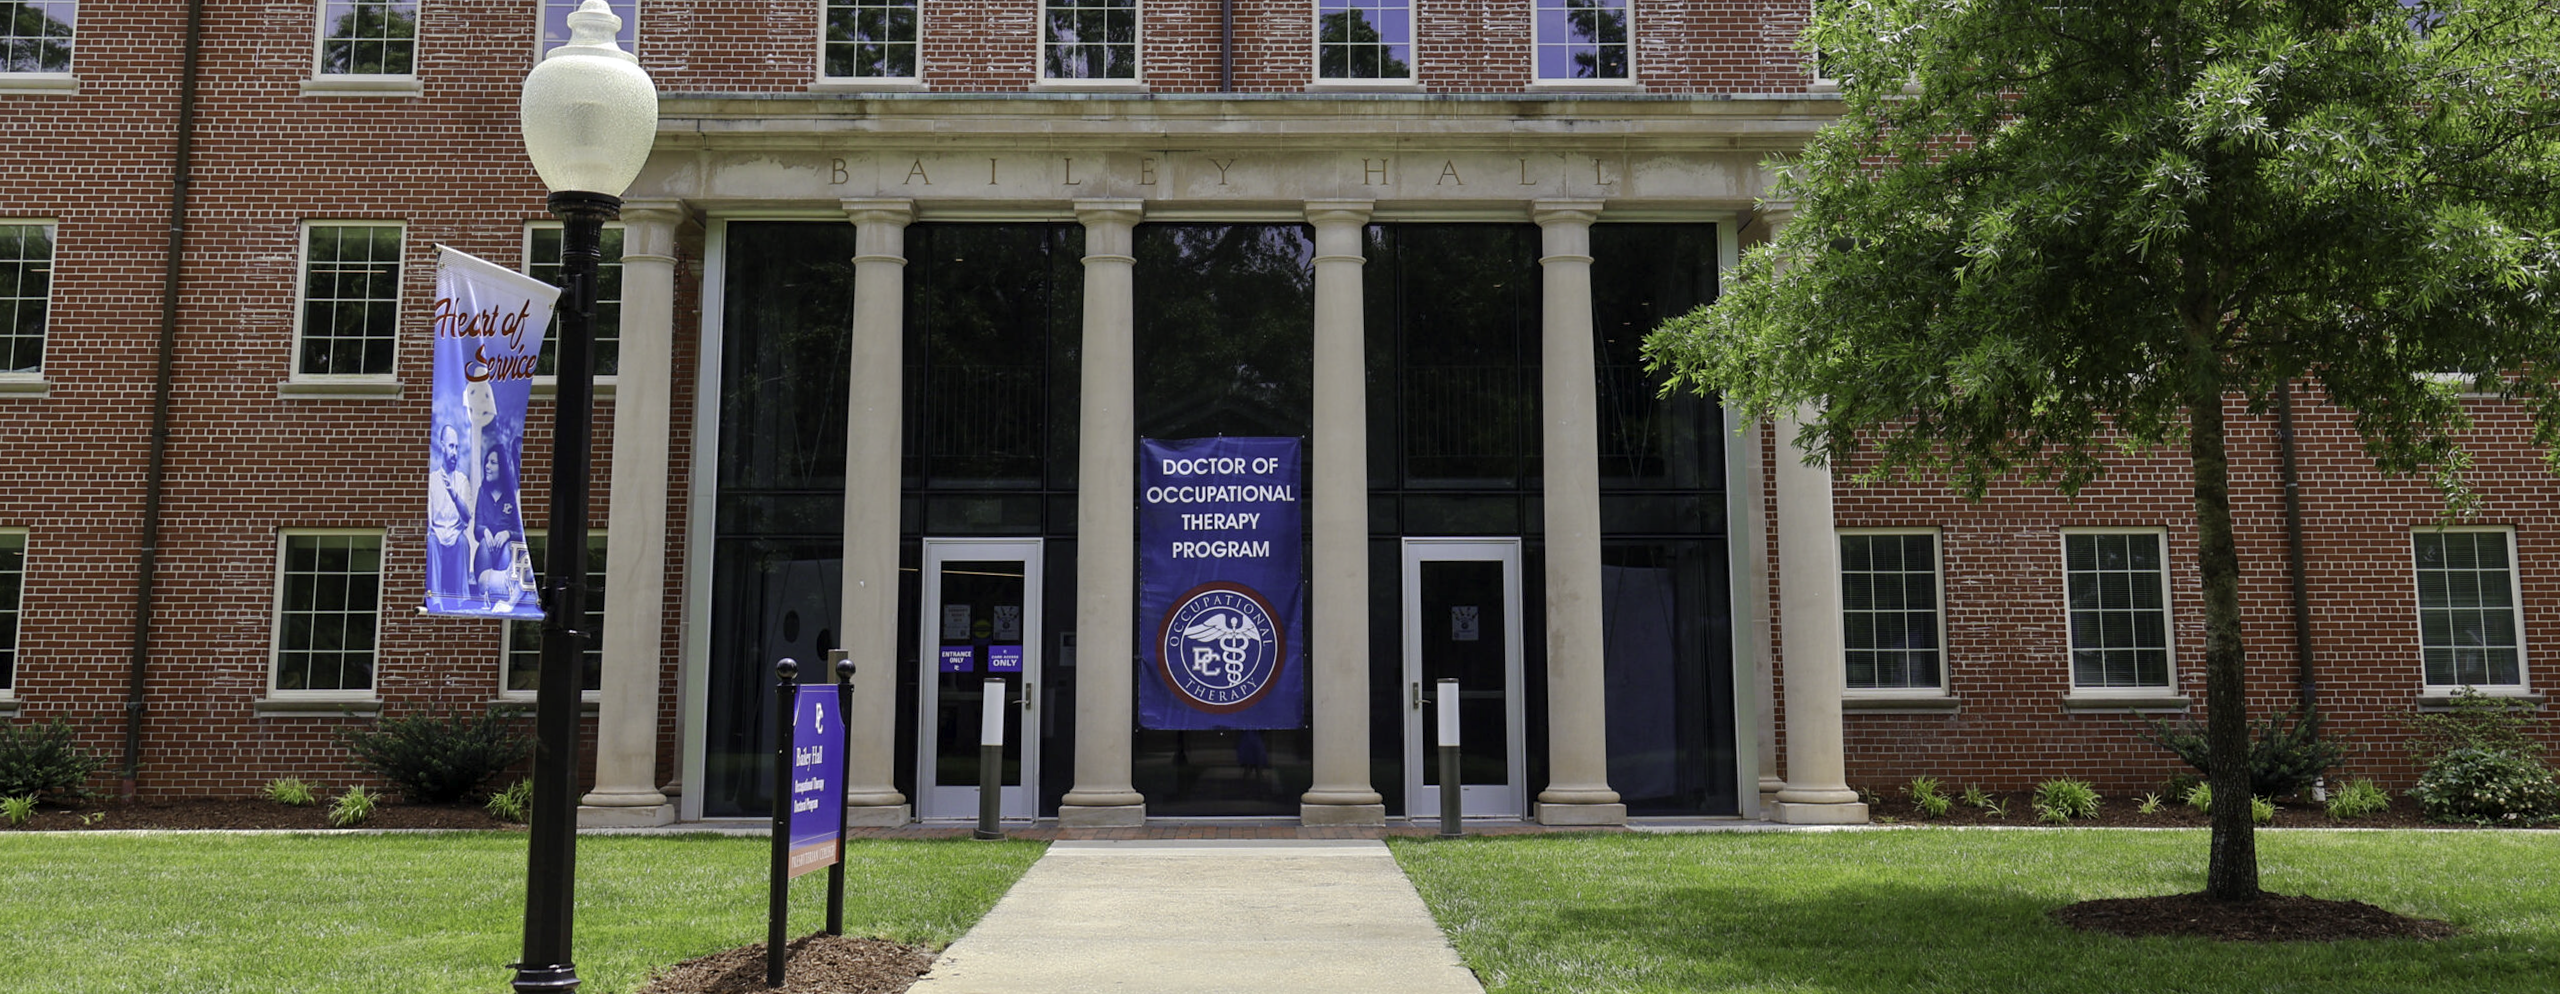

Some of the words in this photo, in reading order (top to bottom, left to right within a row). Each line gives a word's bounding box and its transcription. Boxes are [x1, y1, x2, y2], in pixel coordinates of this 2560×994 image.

[828, 157, 1236, 186] BAILEY
[1361, 157, 1613, 186] HALL
[435, 297, 500, 338] Heart
[501, 298, 531, 351] of
[465, 343, 537, 383] Service
[1162, 458, 1246, 475] DOCTOR
[1252, 457, 1279, 475] OF
[1146, 485, 1295, 504] OCCUPATIONAL
[1181, 513, 1260, 531] THERAPY
[1172, 541, 1270, 558] PROGRAM
[1169, 594, 1273, 648] OCCUPATIONAL
[1192, 646, 1221, 677] PC
[1184, 677, 1258, 702] THERAPY
[796, 747, 812, 772] Bailey
[812, 745, 822, 764] Hall
